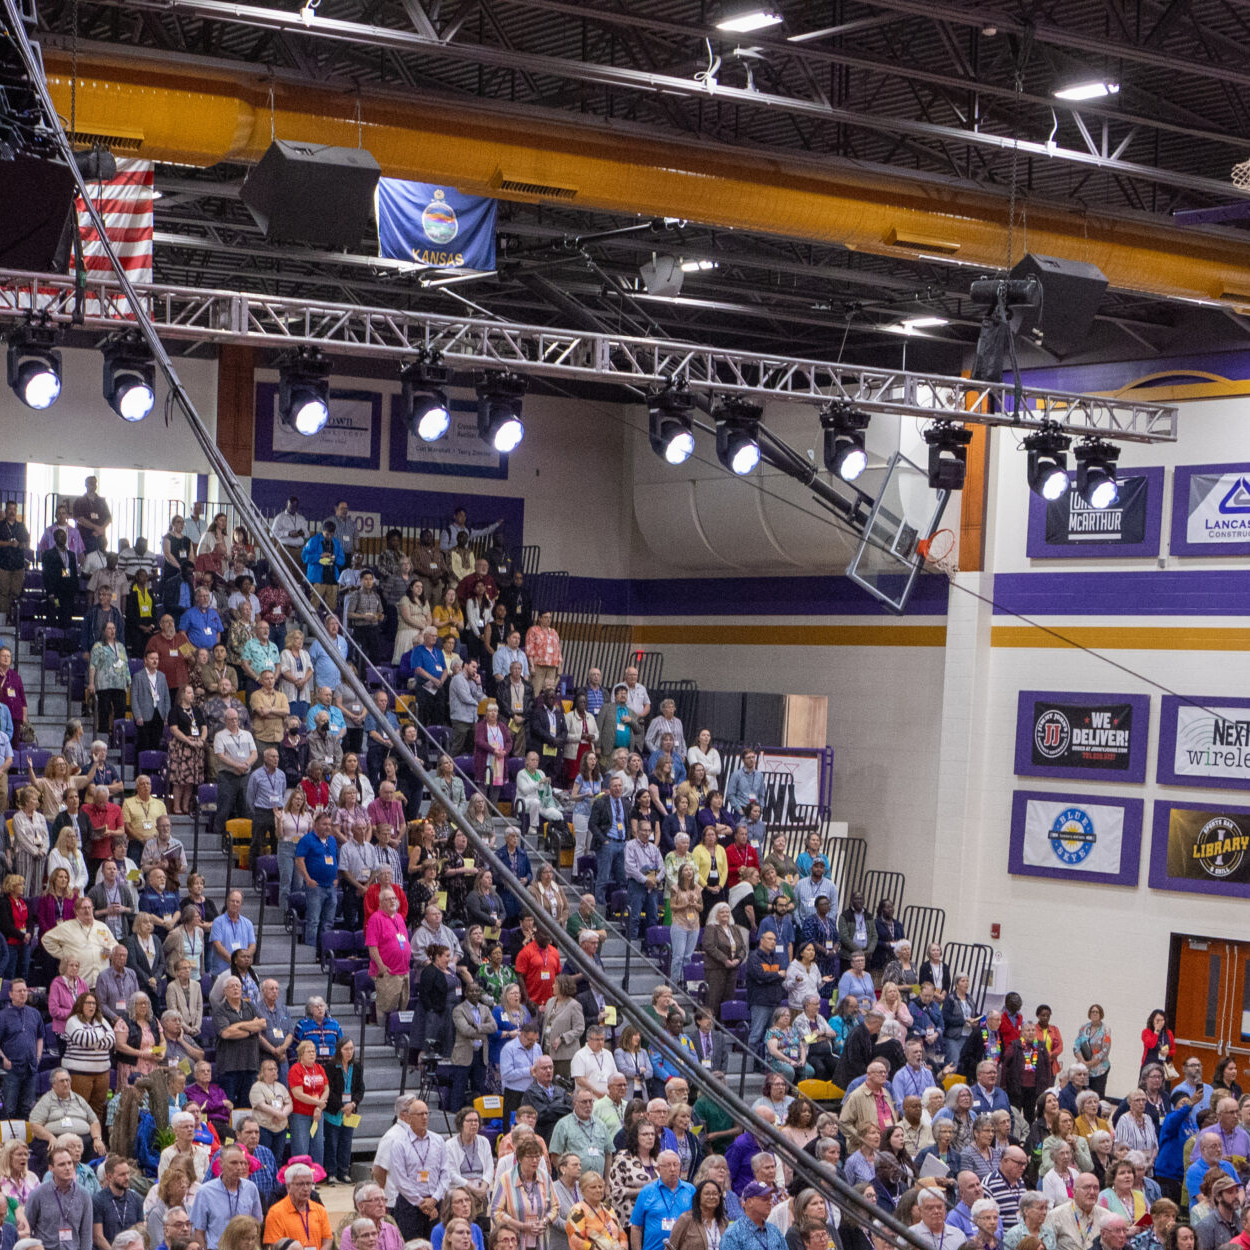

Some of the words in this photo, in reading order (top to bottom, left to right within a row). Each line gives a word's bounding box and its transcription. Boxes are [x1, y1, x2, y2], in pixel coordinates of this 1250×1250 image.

[412, 248, 464, 266] KANSAS
[354, 515, 375, 534] 09
[1068, 512, 1122, 532] McARTHUR
[1091, 712, 1111, 728] WE
[1044, 723, 1061, 746] JJ
[1072, 728, 1129, 747] DELIVER!
[1059, 811, 1089, 826] BLUE
[1193, 836, 1250, 858] LIBRARY
